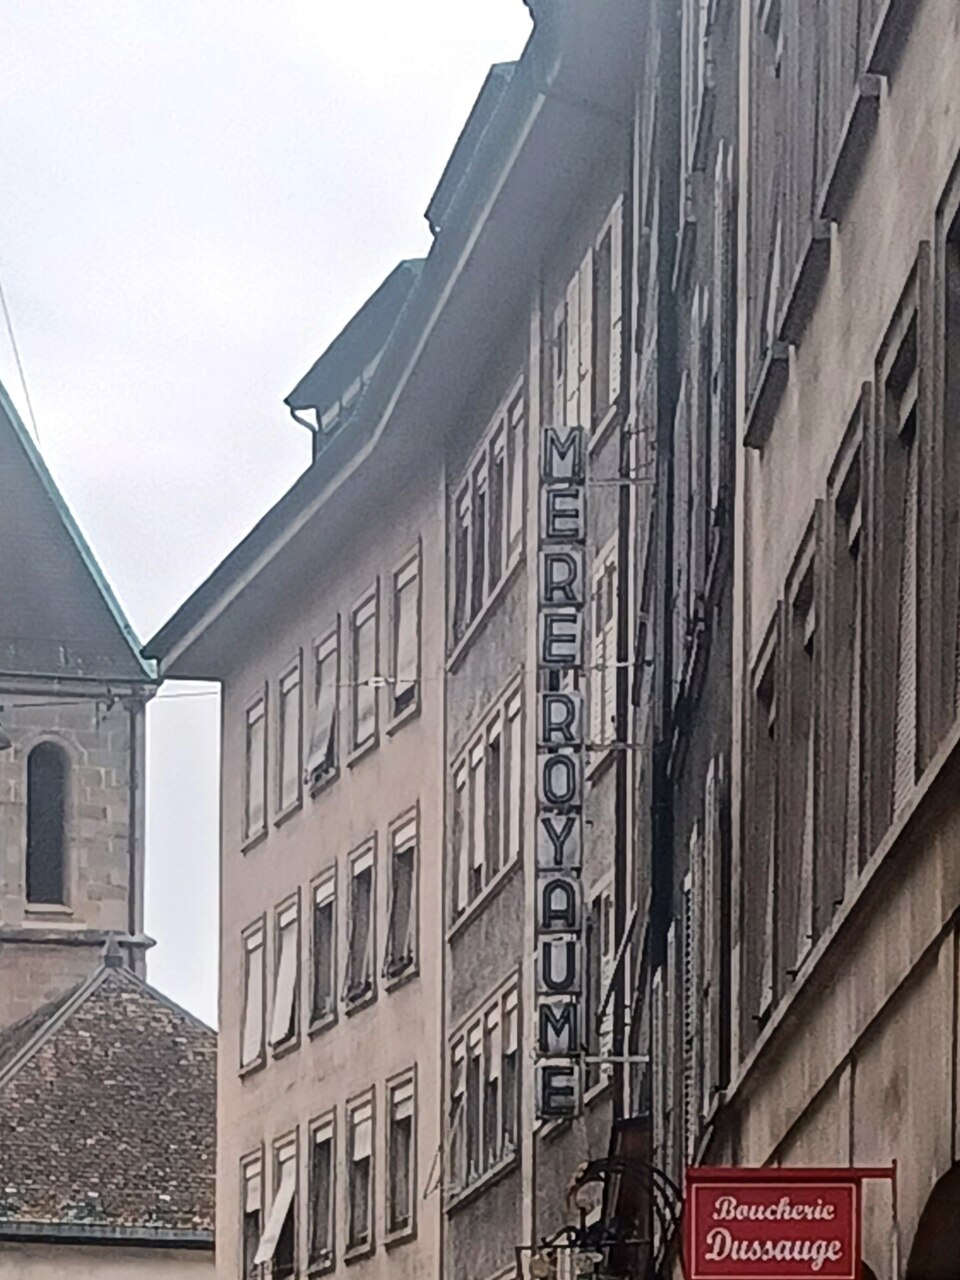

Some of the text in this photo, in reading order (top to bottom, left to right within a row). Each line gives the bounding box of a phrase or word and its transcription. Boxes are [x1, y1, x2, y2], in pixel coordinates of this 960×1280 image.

[538, 427, 582, 1116] MERE ROYAUME
[712, 1196, 836, 1222] Boucherie
[704, 1227, 843, 1271] Dussauge
